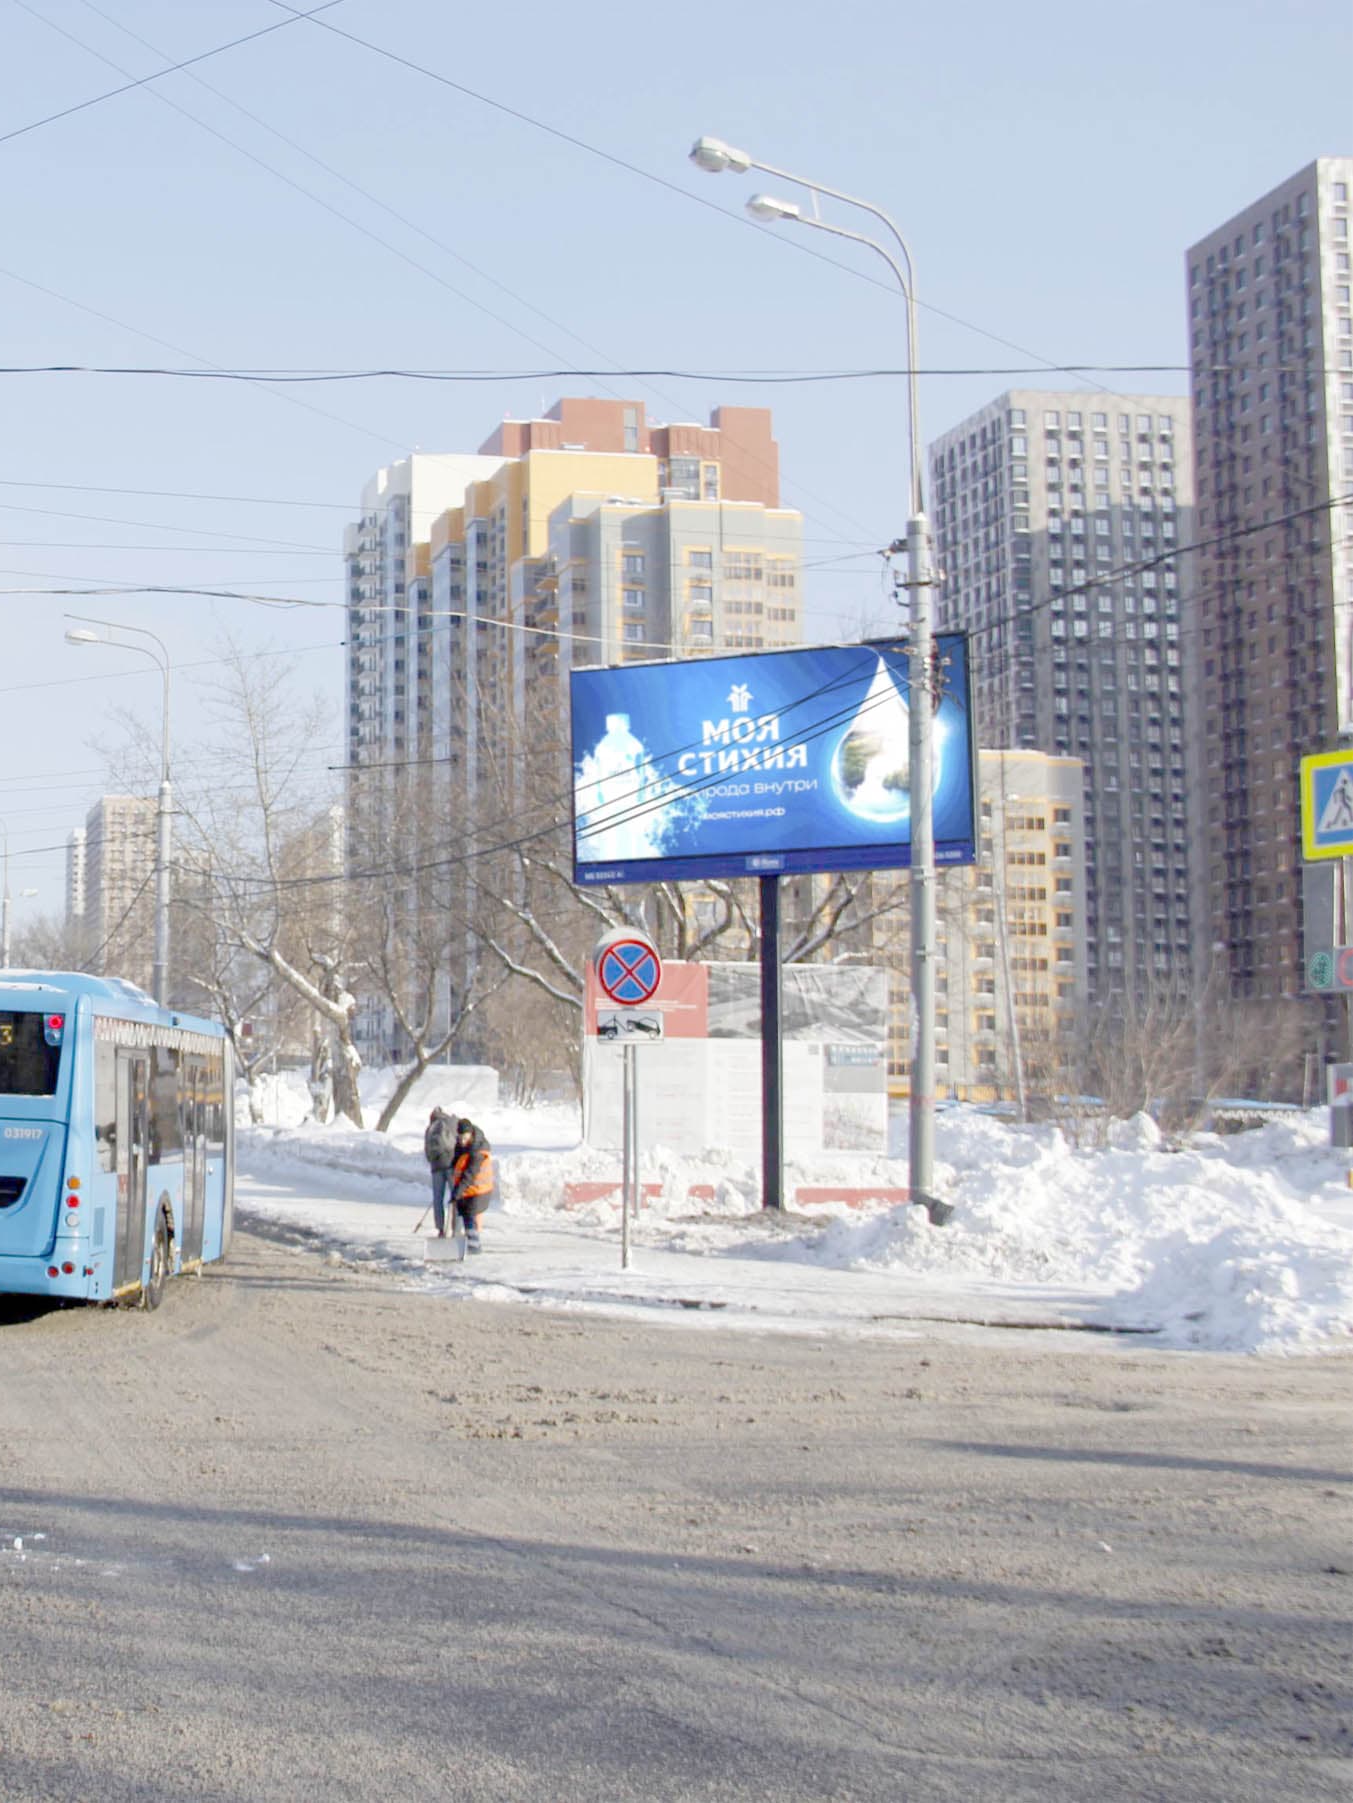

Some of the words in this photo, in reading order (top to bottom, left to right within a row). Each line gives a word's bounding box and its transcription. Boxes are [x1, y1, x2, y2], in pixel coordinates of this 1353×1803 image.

[702, 715, 779, 746] МОЯ
[678, 744, 807, 775] СТИХИЯ
[754, 780, 818, 795] внутри
[0, 1025, 12, 1045] 3
[4, 1128, 42, 1140] 031917
